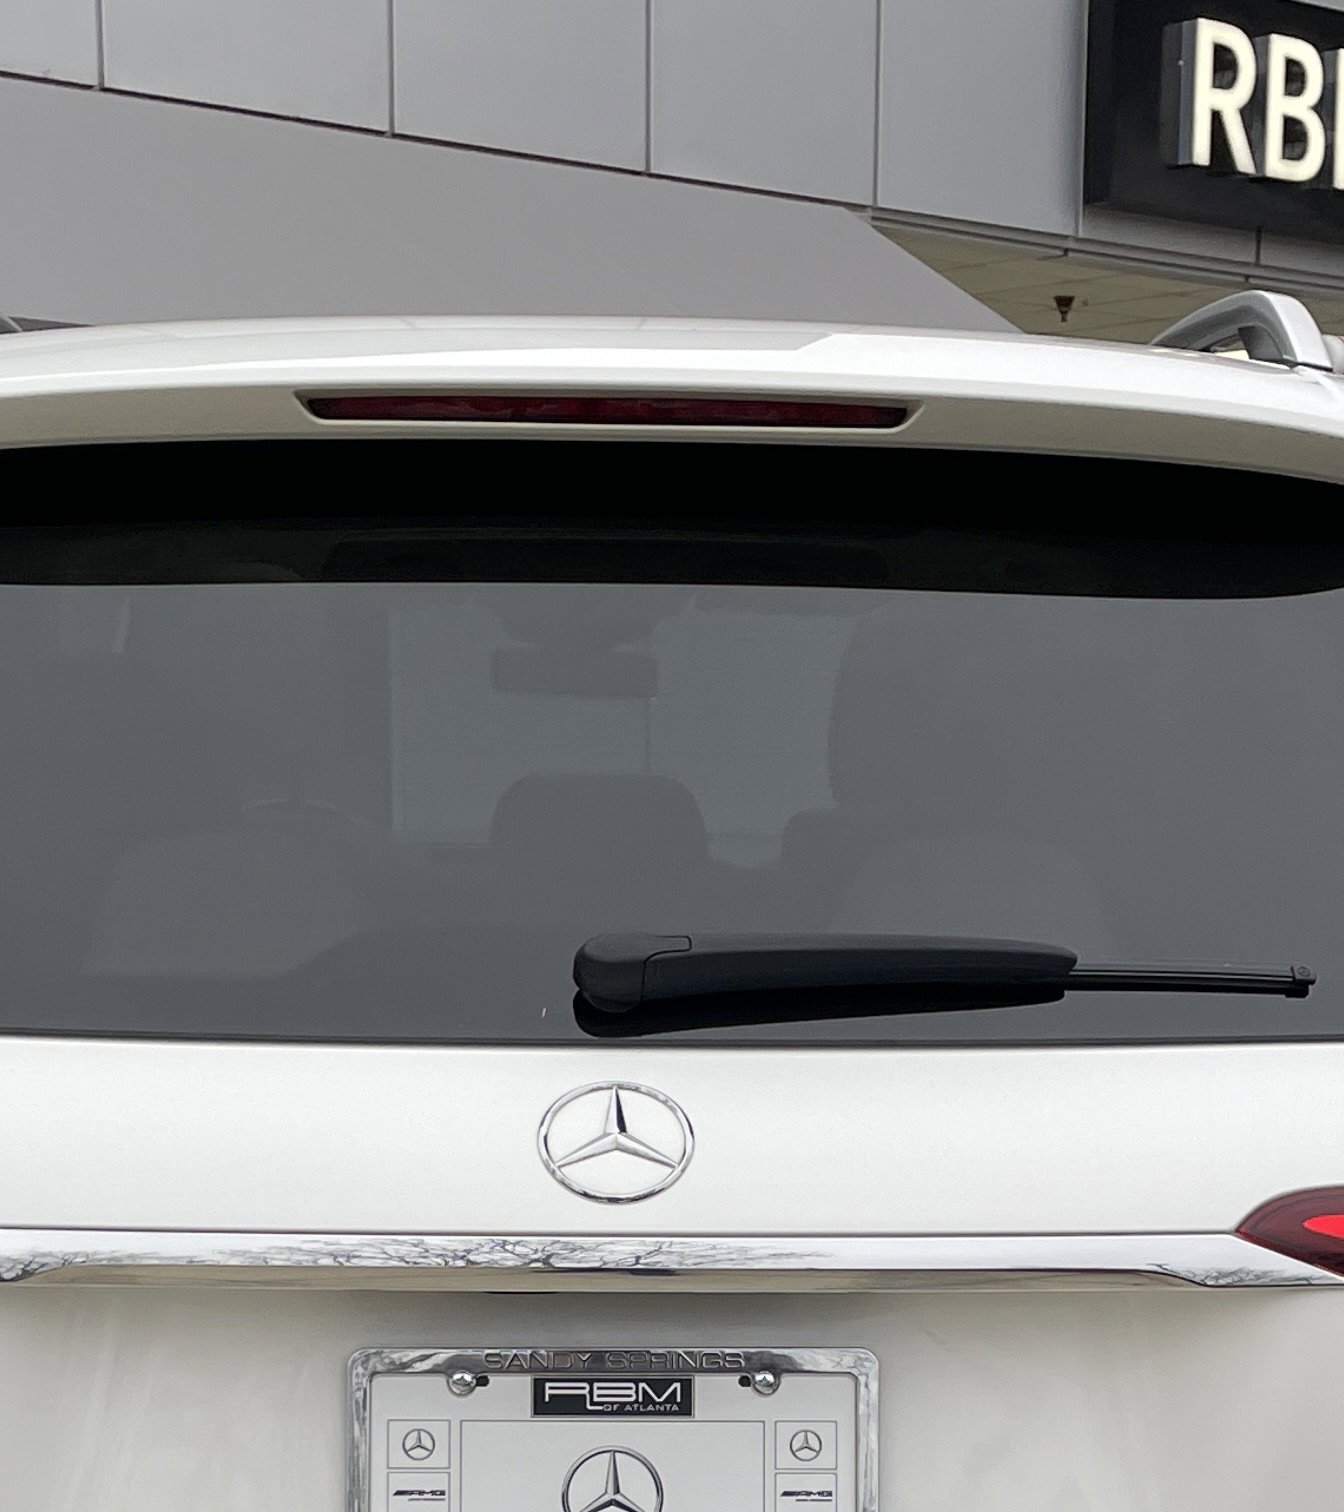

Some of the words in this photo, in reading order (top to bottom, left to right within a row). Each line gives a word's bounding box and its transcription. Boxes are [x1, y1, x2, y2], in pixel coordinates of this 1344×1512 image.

[483, 1351, 593, 1370] SANDY
[607, 1350, 746, 1370] SPRINGS
[544, 1381, 682, 1411] RBM
[603, 1403, 618, 1411] OF
[624, 1403, 680, 1412] ATLANTA
